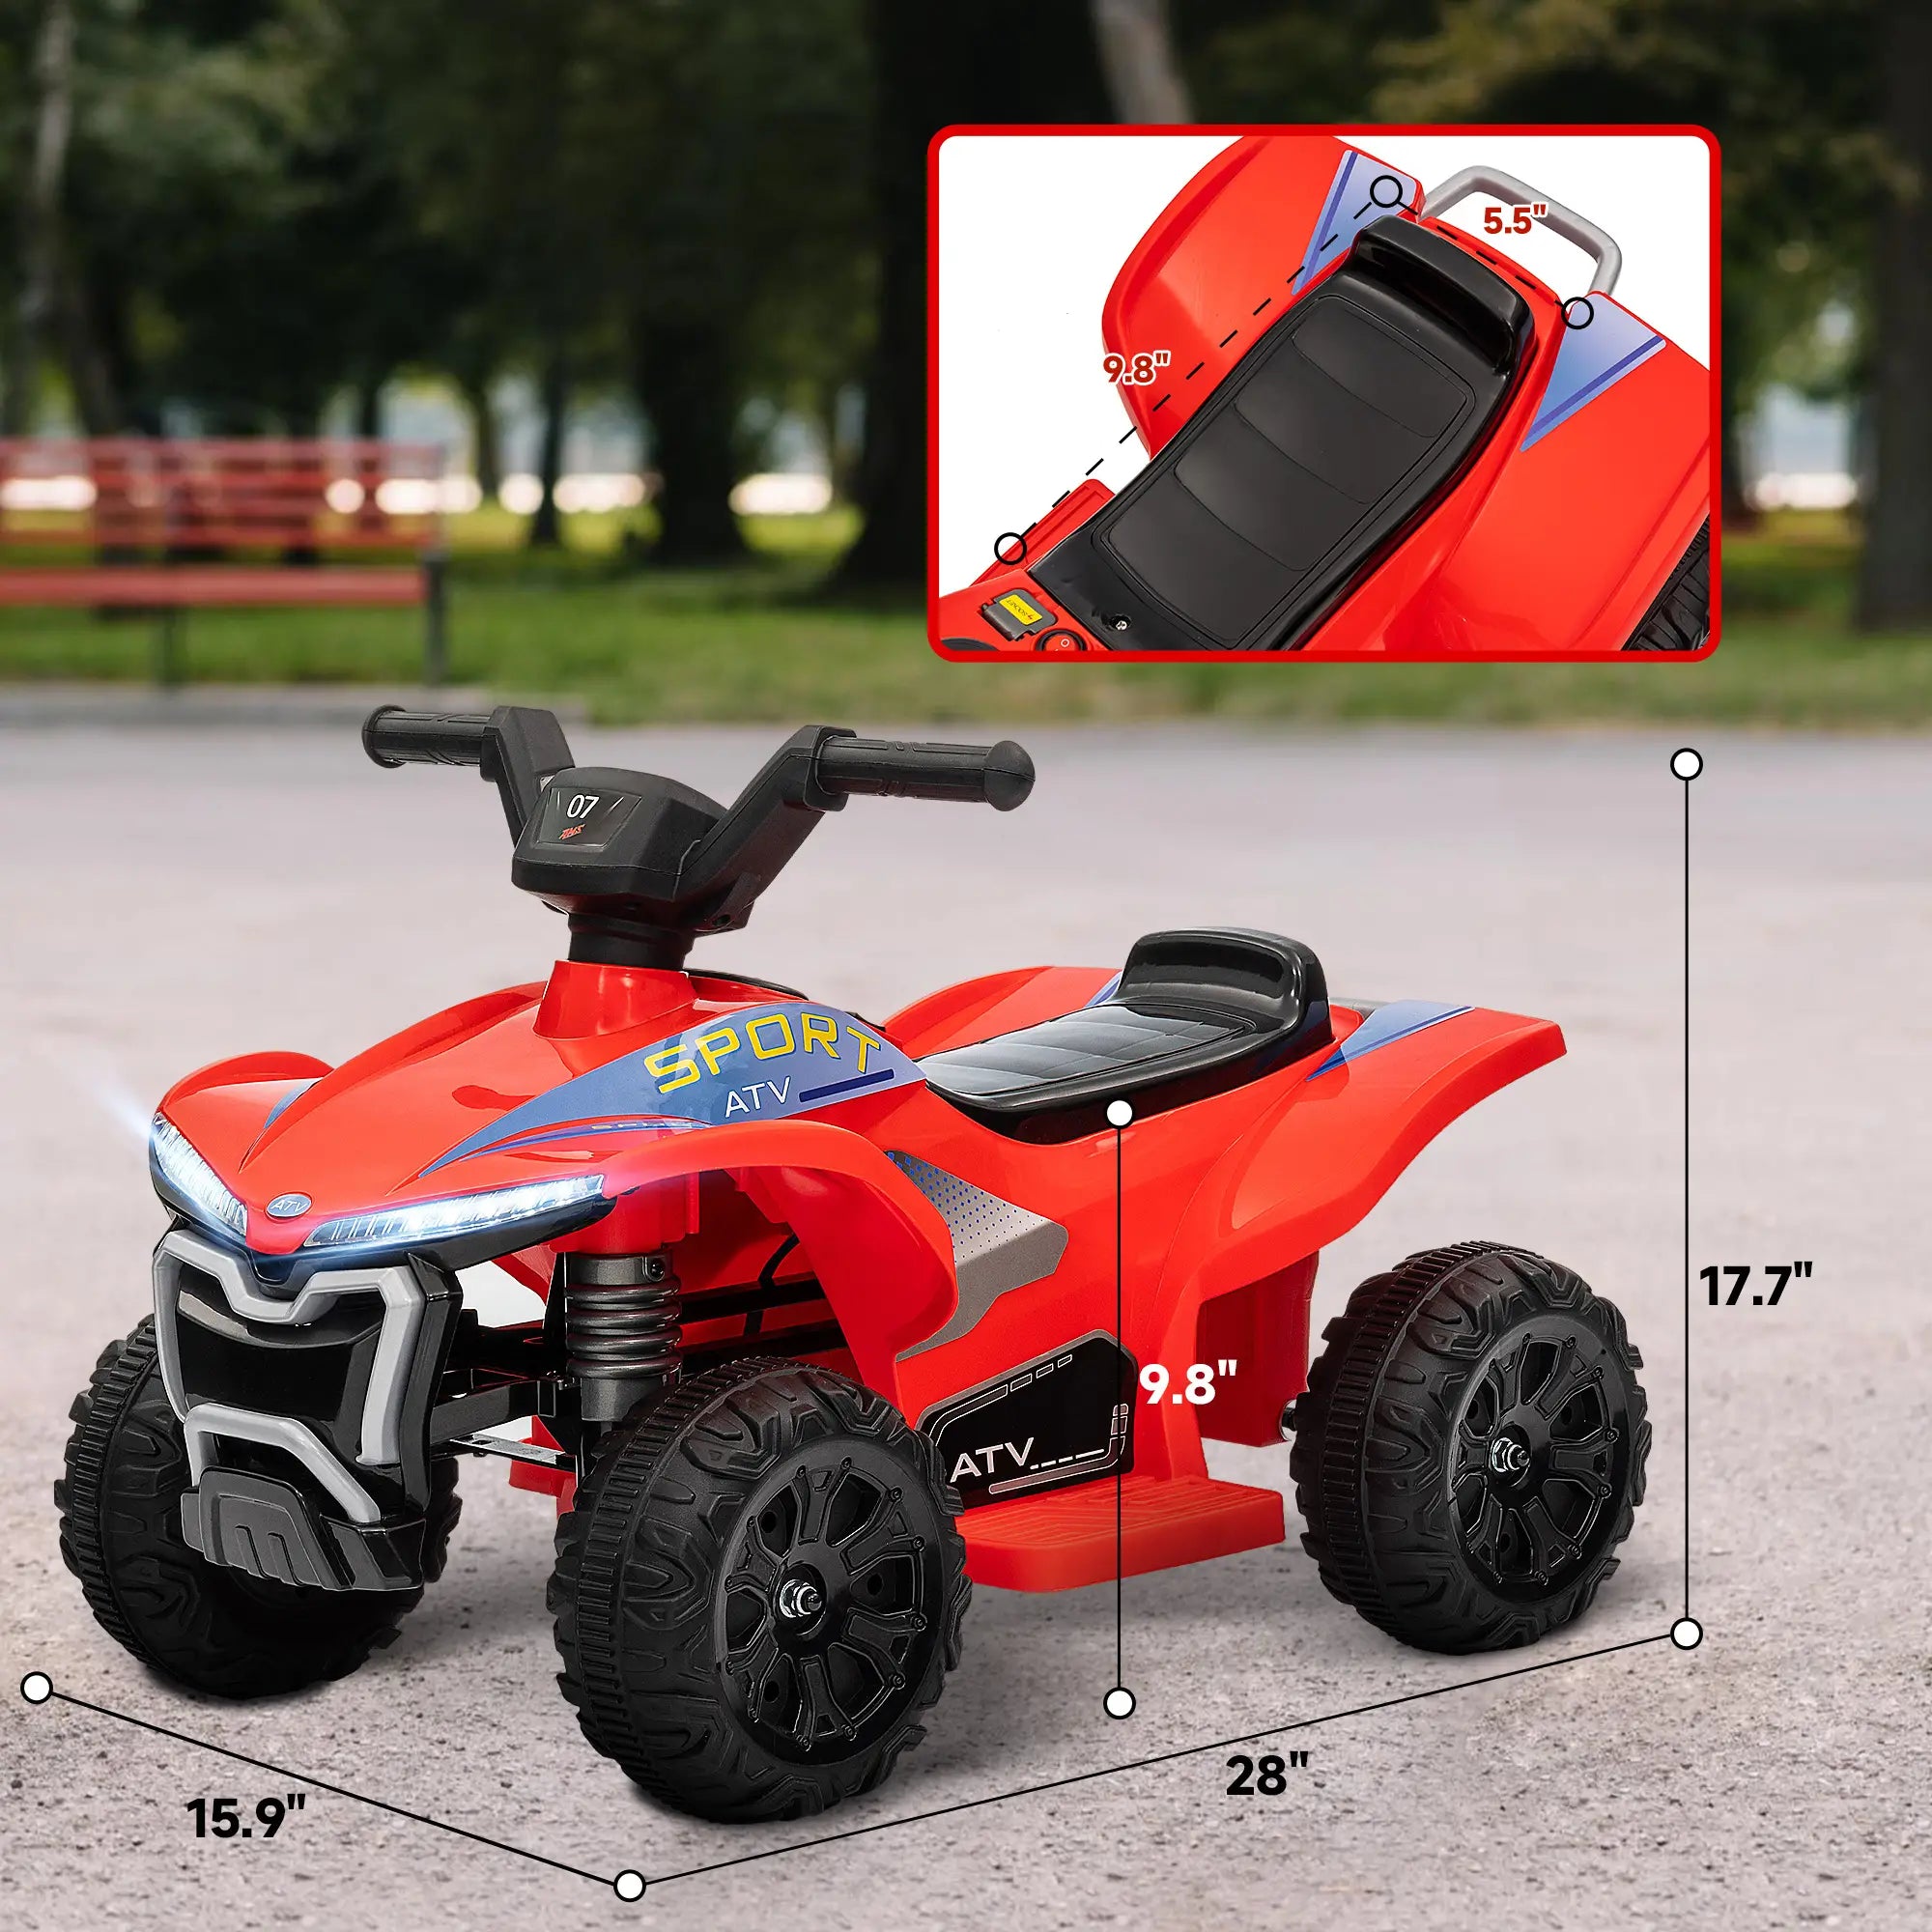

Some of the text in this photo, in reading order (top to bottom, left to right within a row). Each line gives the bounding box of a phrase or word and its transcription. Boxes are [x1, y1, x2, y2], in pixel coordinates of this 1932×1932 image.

[567, 794, 600, 819] 07
[644, 1013, 881, 1094] SPORT
[724, 1076, 791, 1119] ATV
[270, 1199, 308, 1212] ATV
[950, 1437, 1035, 1483] ATV
